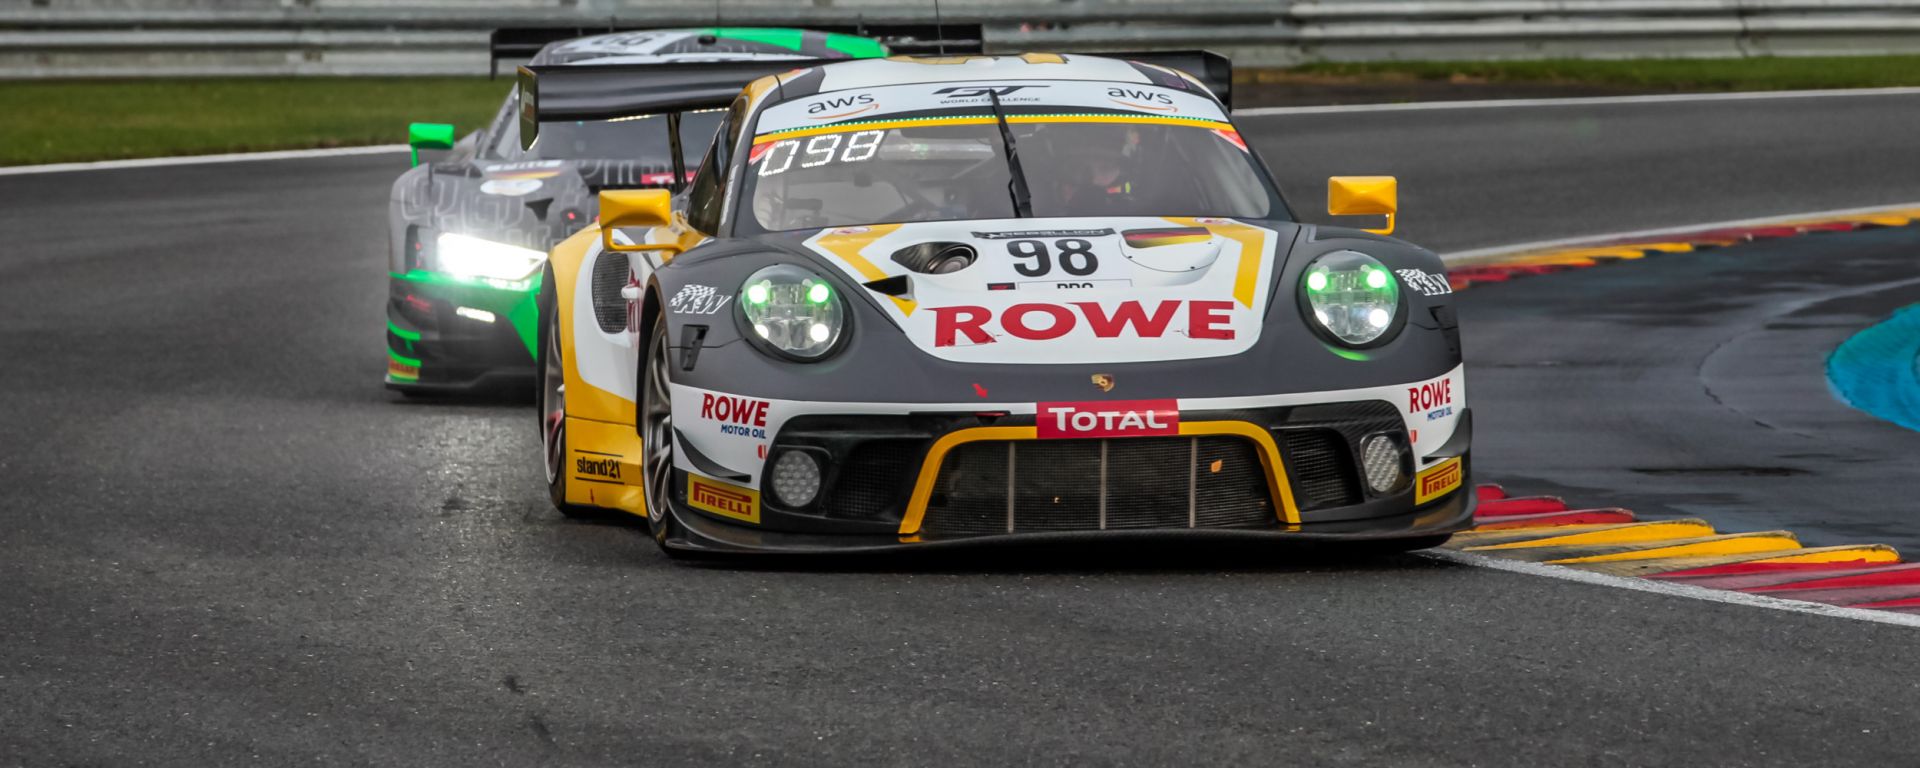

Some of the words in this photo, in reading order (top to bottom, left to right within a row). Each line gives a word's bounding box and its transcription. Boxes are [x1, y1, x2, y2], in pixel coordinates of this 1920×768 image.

[808, 93, 875, 114] aws
[1107, 87, 1173, 105] aws
[758, 129, 884, 176] 098
[1000, 228, 1104, 238] REBELLION
[1007, 239, 1098, 277] 98
[923, 300, 1235, 347] ROWE
[701, 393, 770, 427] ROWE
[1408, 378, 1451, 413] ROWE
[720, 424, 750, 436] MOTOR
[751, 428, 766, 439] OIL
[577, 456, 621, 479] stand21
[1421, 462, 1459, 497] PIRELLI
[693, 481, 752, 516] PIRELLI
